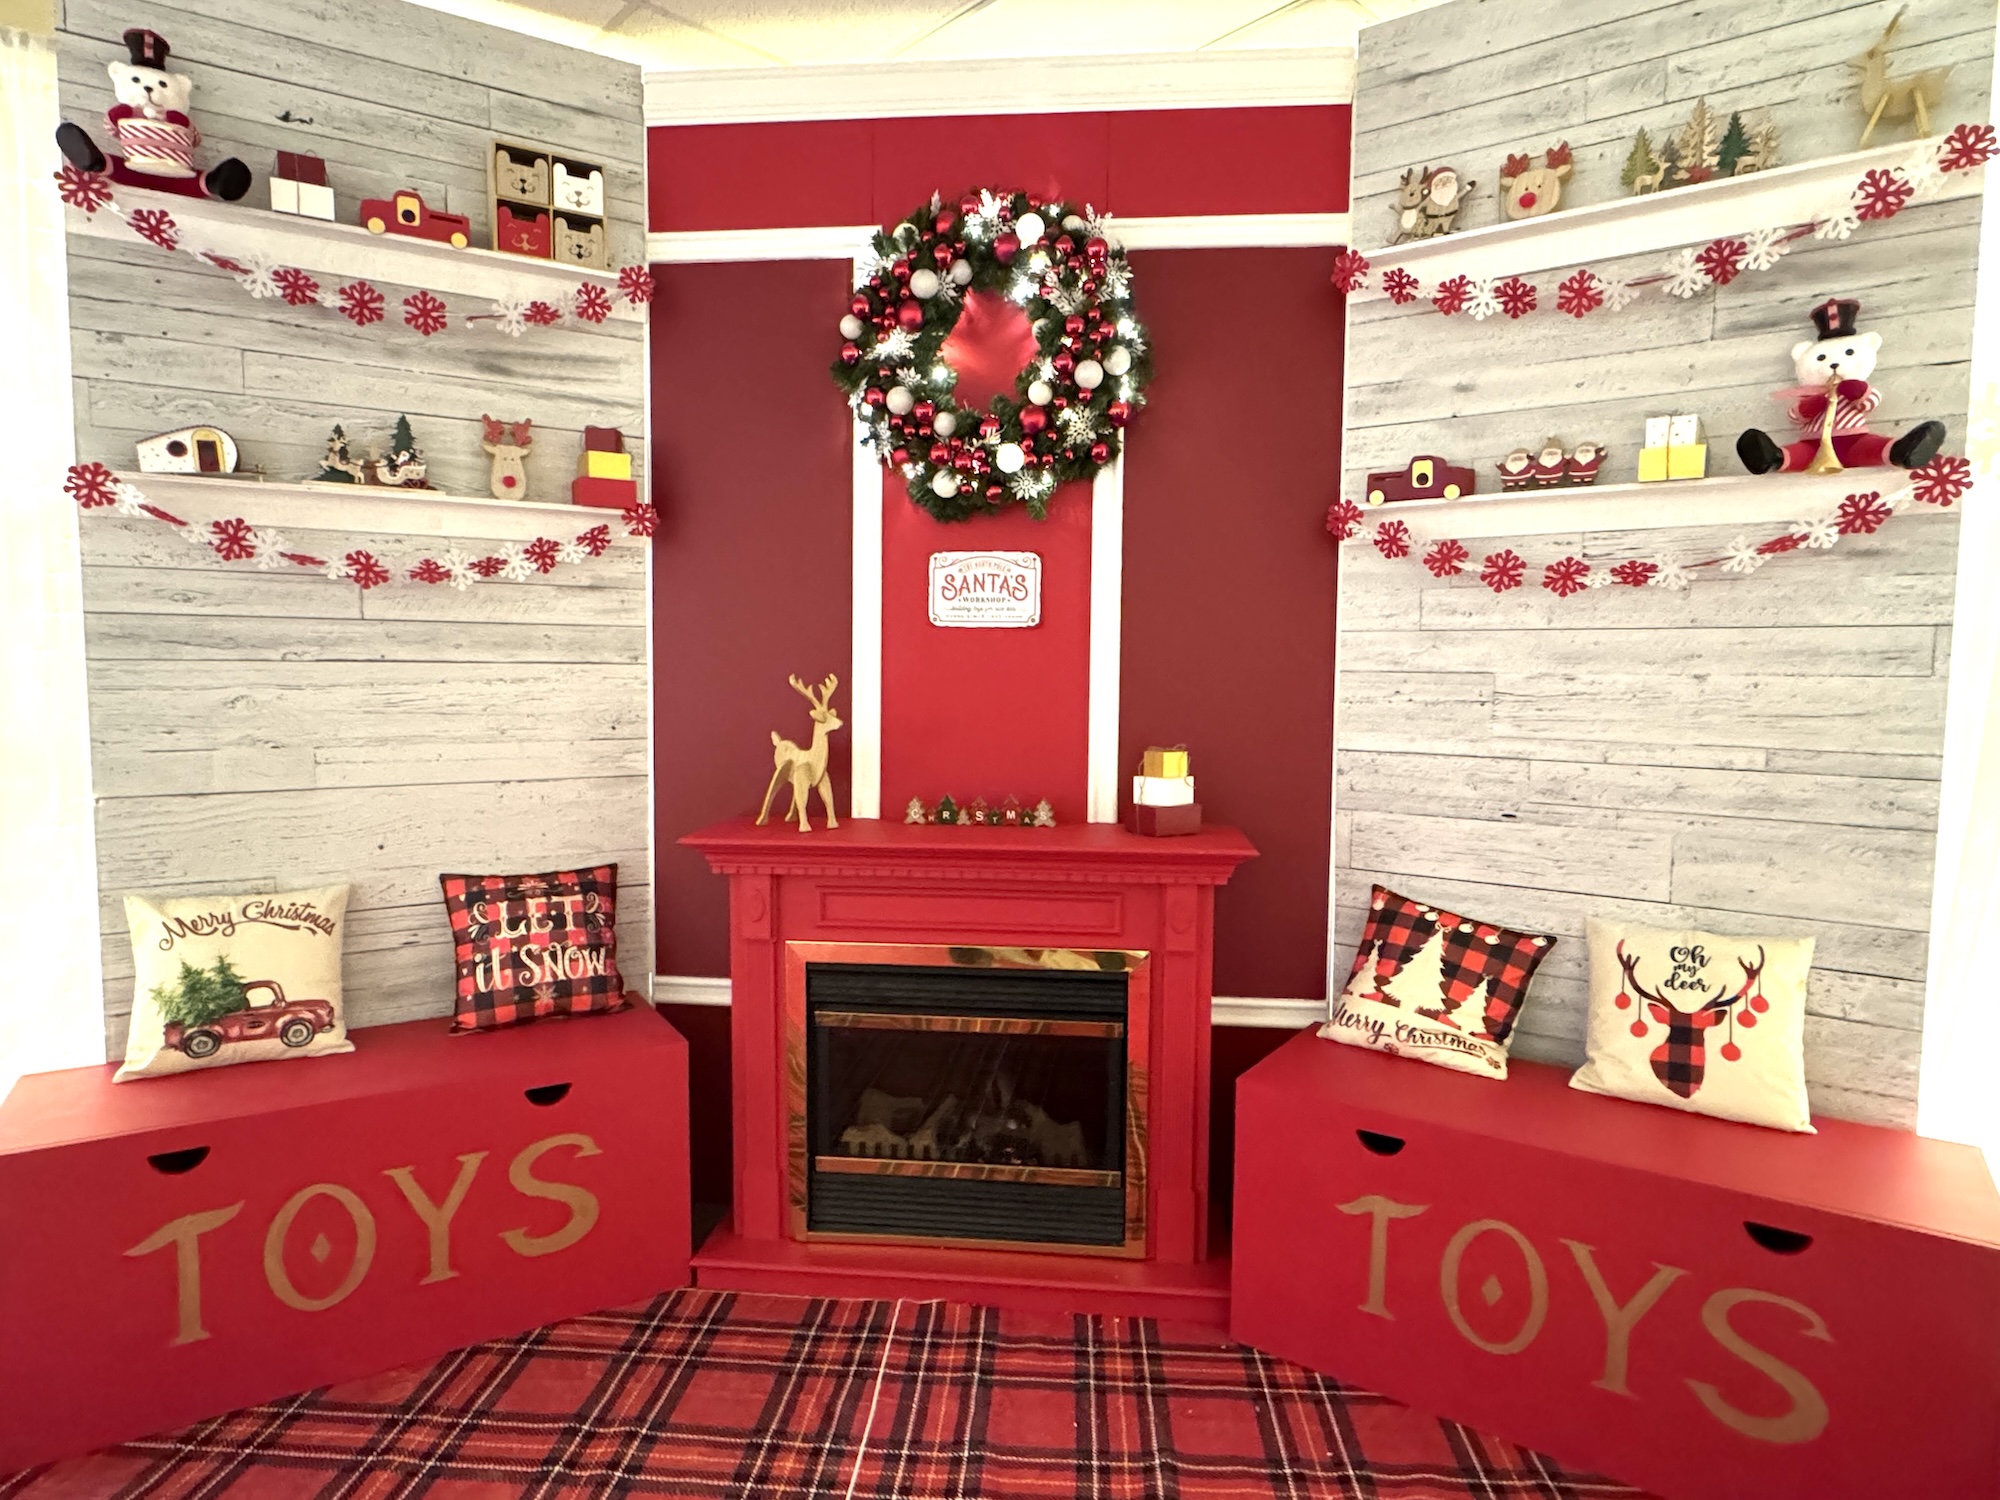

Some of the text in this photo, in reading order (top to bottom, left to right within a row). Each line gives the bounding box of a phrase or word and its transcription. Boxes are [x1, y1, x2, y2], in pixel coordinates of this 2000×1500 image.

[941, 573, 1028, 601] SANTA'S
[911, 809, 1048, 824] CHRSTMAS
[159, 900, 336, 951] Merry Christmas
[494, 894, 583, 940] LET
[519, 942, 607, 987] SNOW
[1669, 945, 1712, 968] Oh
[1673, 962, 1701, 978] my
[1664, 972, 1711, 993] deer
[1395, 1019, 1488, 1056] Christmas
[122, 1133, 603, 1346] TOYS
[1335, 1195, 1836, 1445] TOYS
